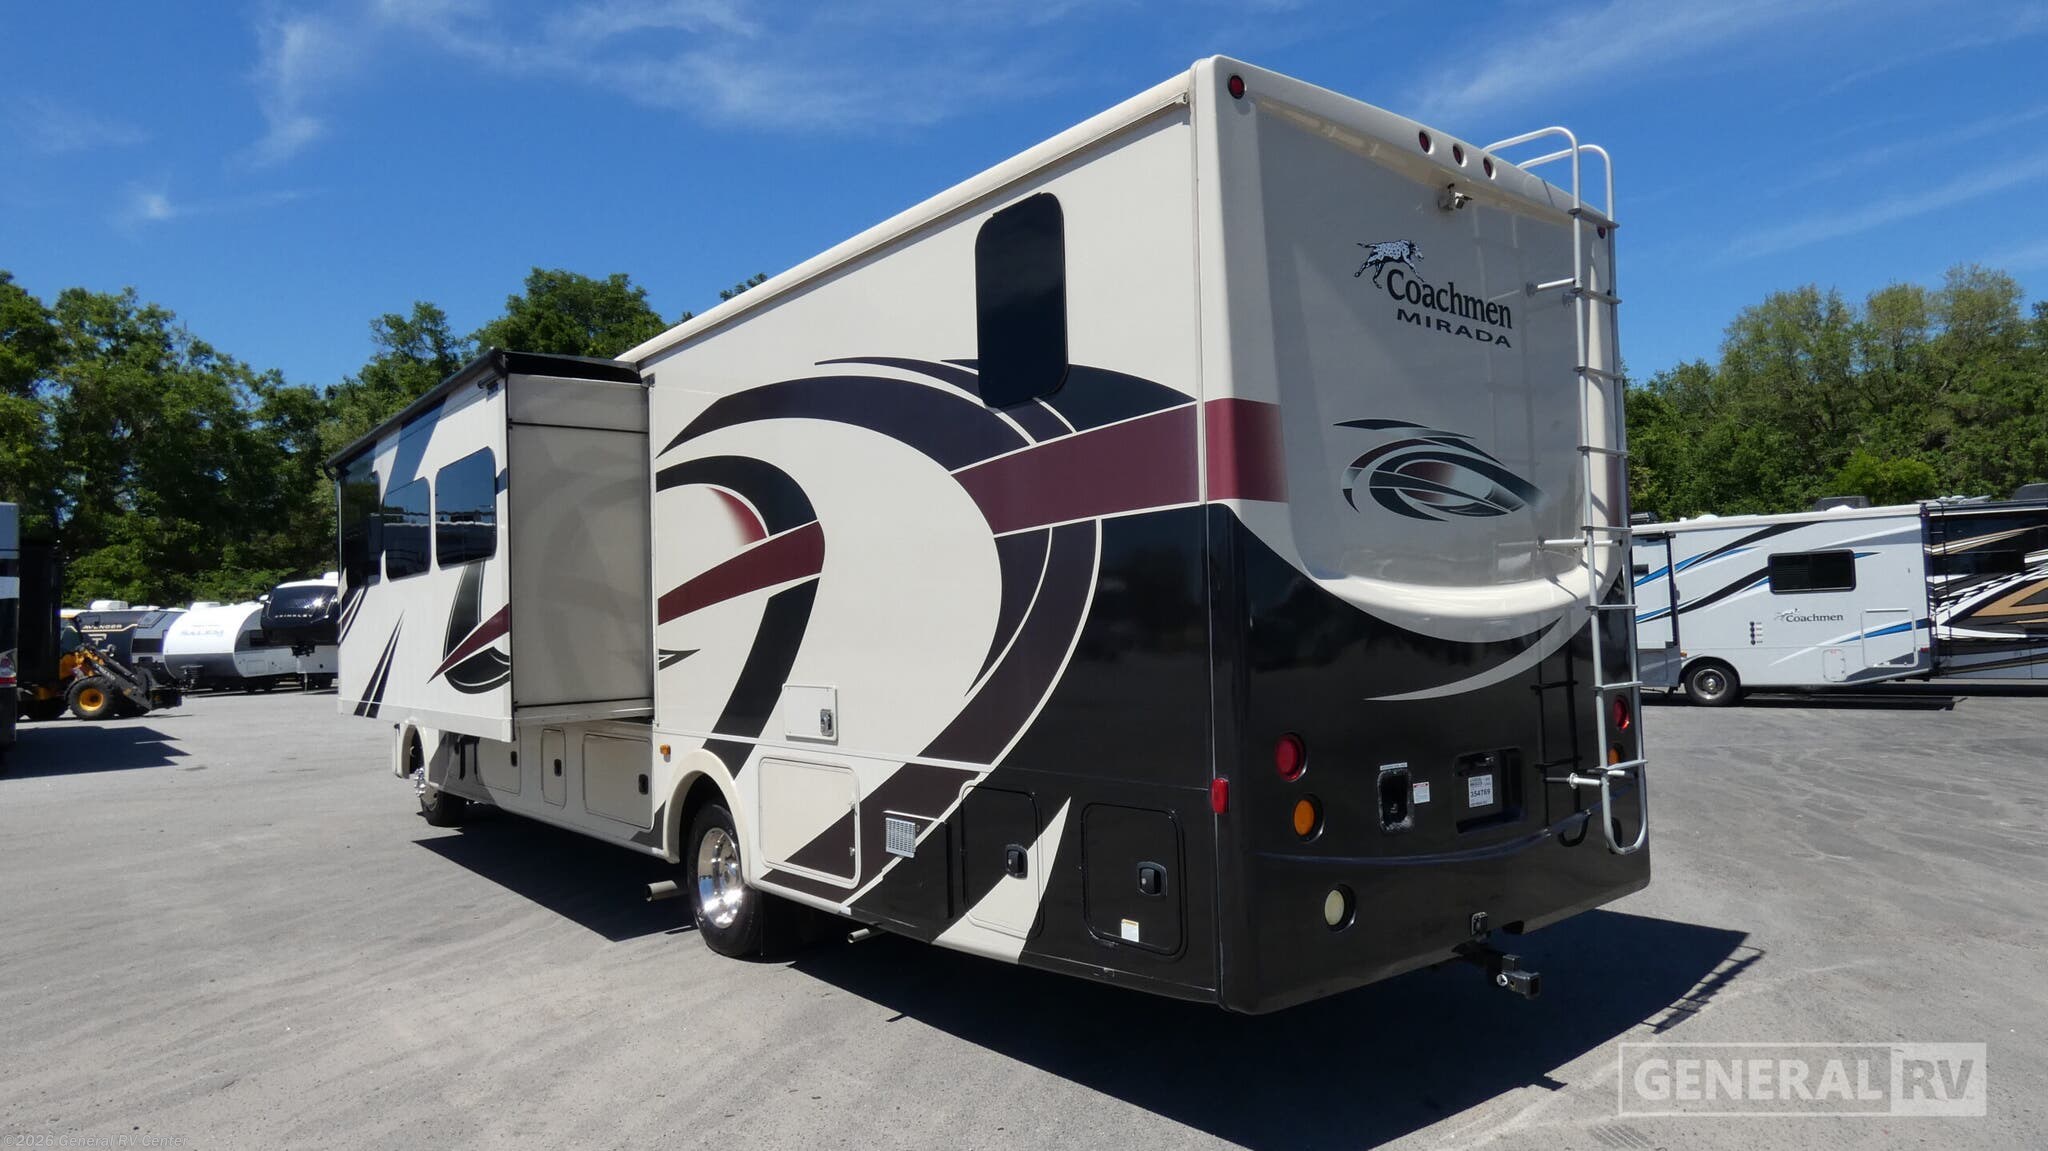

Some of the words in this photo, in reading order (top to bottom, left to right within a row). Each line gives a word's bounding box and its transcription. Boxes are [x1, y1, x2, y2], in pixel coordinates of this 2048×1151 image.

[1386, 268, 1513, 330] Coachmen
[1397, 308, 1513, 349] MIRADA
[1785, 613, 1844, 623] Coachmen
